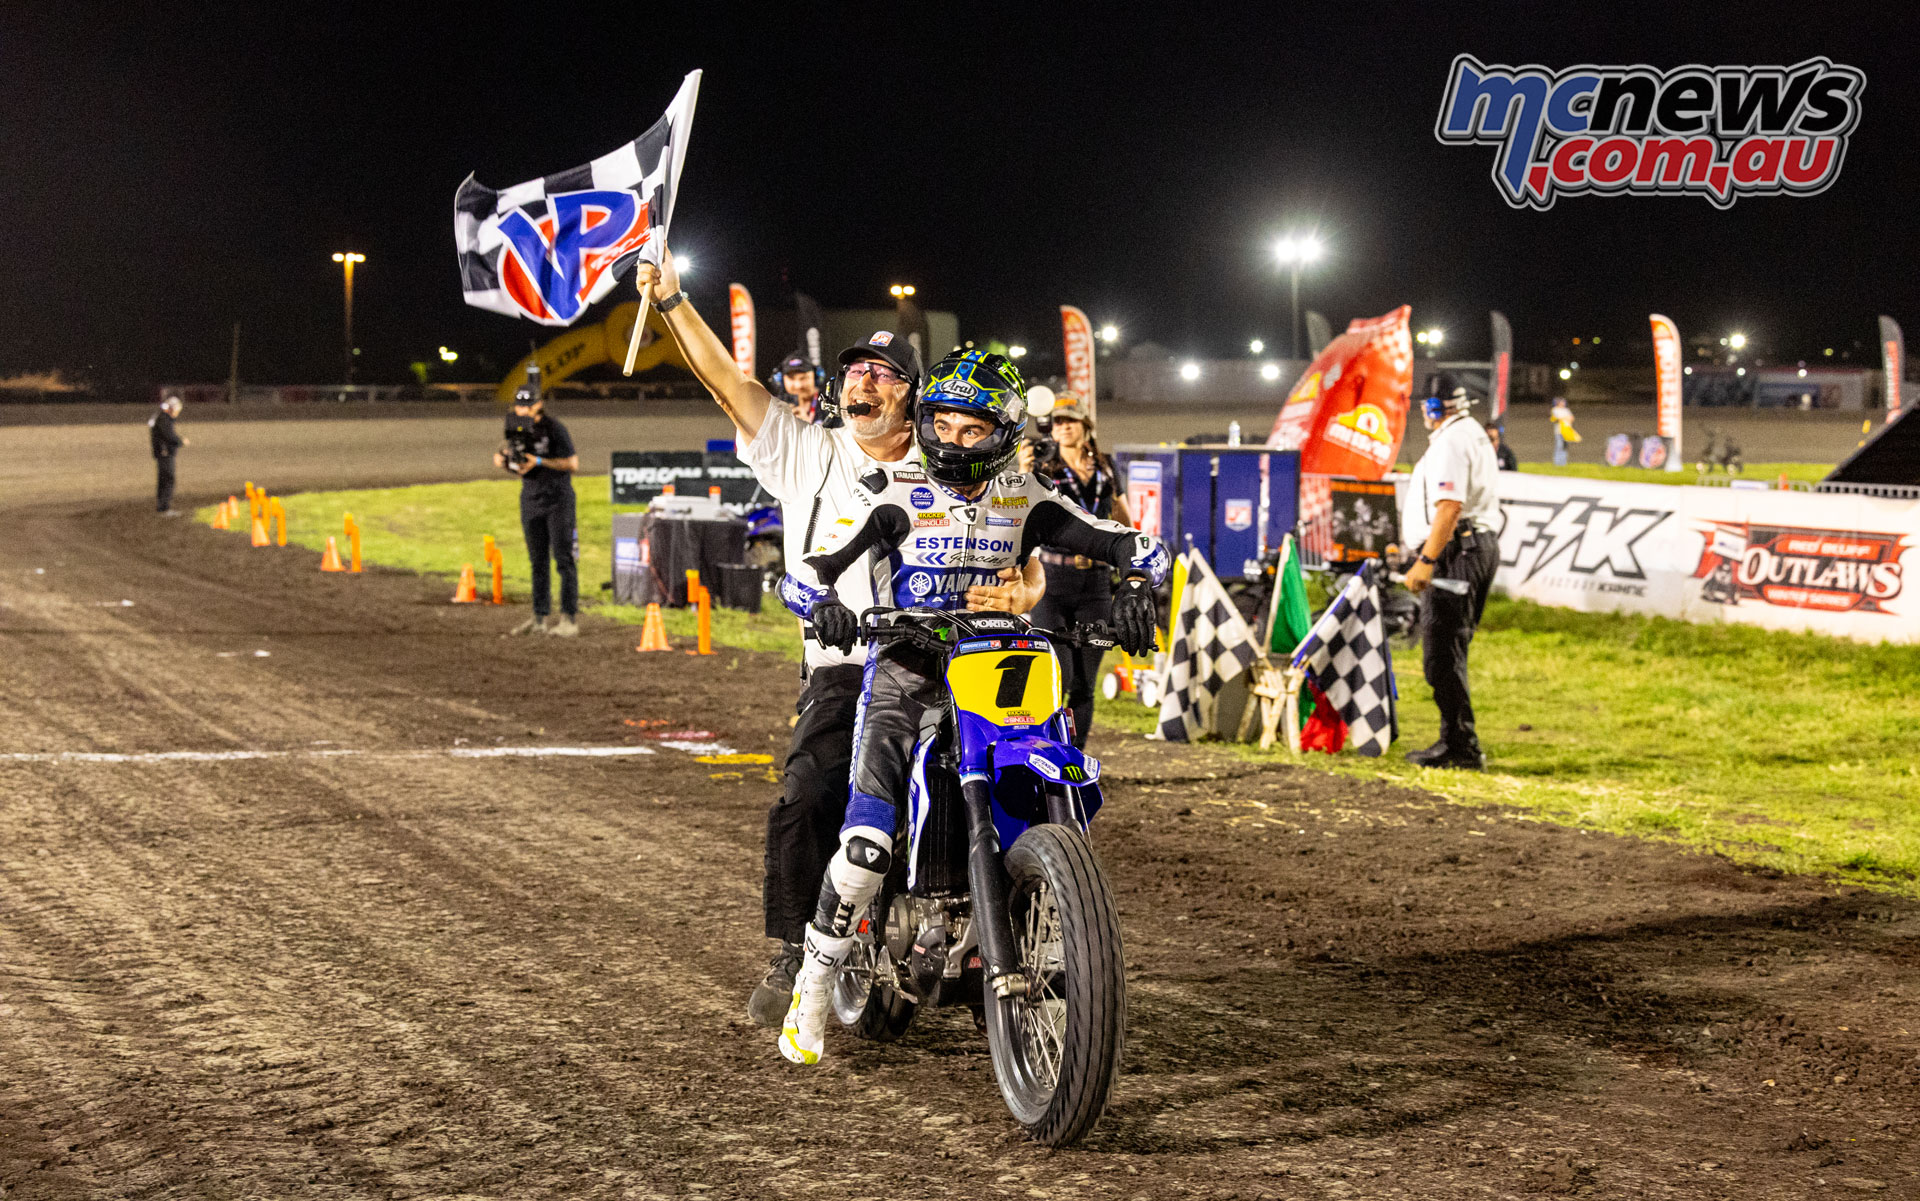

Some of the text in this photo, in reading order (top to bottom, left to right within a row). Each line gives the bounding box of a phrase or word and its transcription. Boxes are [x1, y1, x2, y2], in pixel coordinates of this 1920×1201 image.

[496, 191, 636, 320] VP
[944, 381, 973, 394] Arai
[915, 536, 1014, 553] ESTENSON
[948, 551, 1009, 567] Racing
[1737, 547, 1902, 599] OUTLAWS
[969, 618, 1015, 629] VORTEX
[994, 654, 1039, 709] 1
